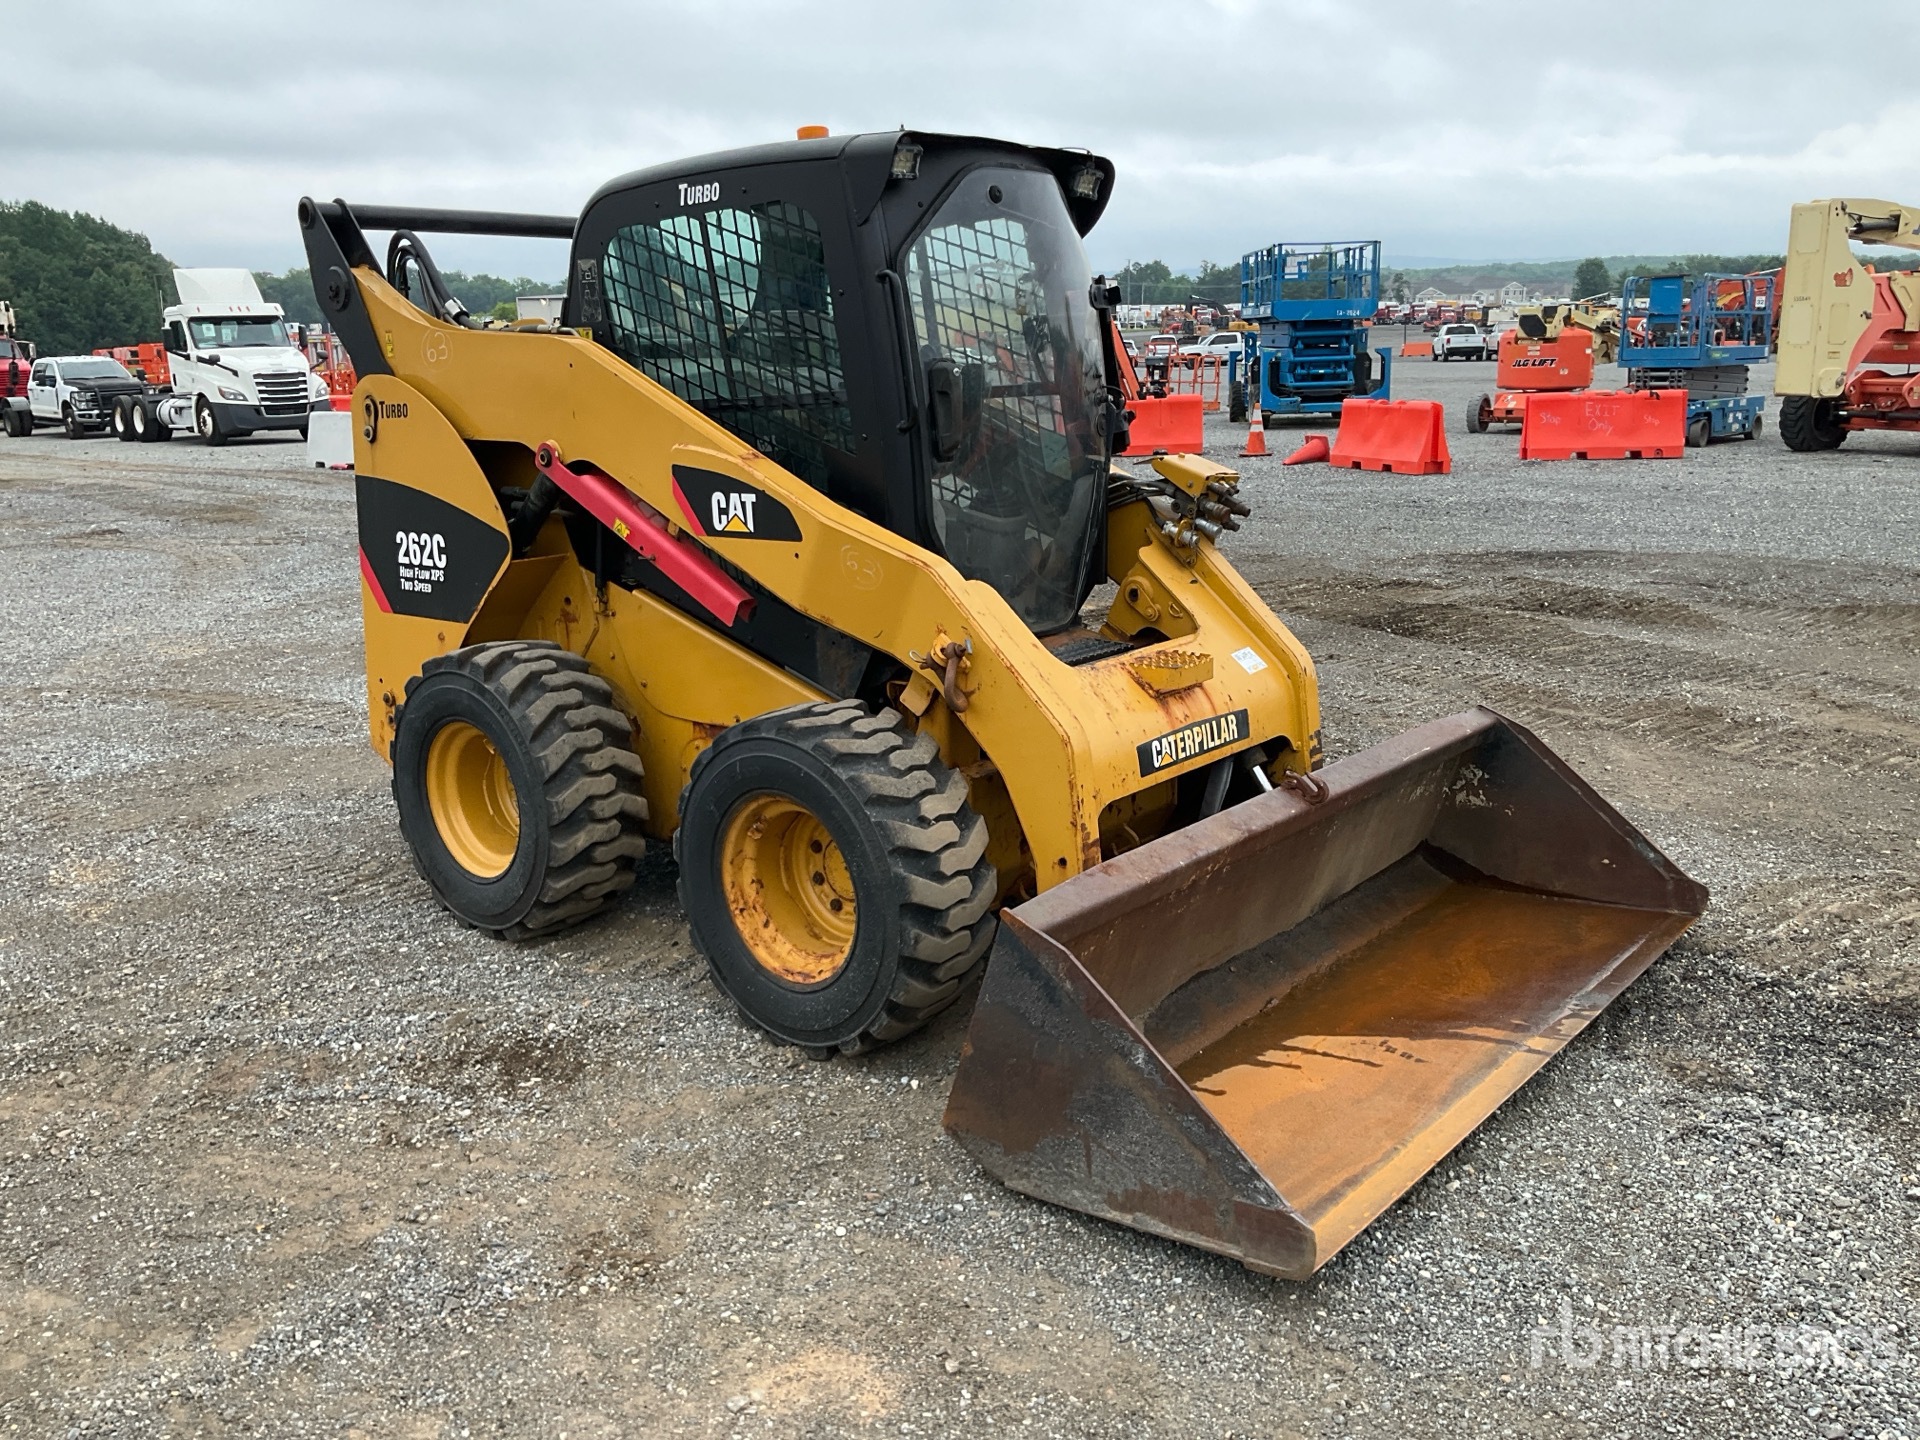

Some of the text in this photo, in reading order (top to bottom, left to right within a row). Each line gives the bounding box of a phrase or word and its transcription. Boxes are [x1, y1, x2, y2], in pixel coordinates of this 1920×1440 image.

[679, 182, 719, 206] TURBO
[426, 331, 448, 362] 63
[1512, 358, 1557, 367] JLG LIFT
[379, 401, 408, 418] TURBO
[1585, 401, 1621, 417] EXIT
[1539, 412, 1561, 426] Stop
[1587, 418, 1613, 436] Only
[1643, 413, 1660, 426] Stop
[711, 491, 756, 533] CAT
[395, 530, 447, 569] 262C
[430, 569, 445, 582] XPS
[1151, 714, 1238, 769] CATERPILLAR
